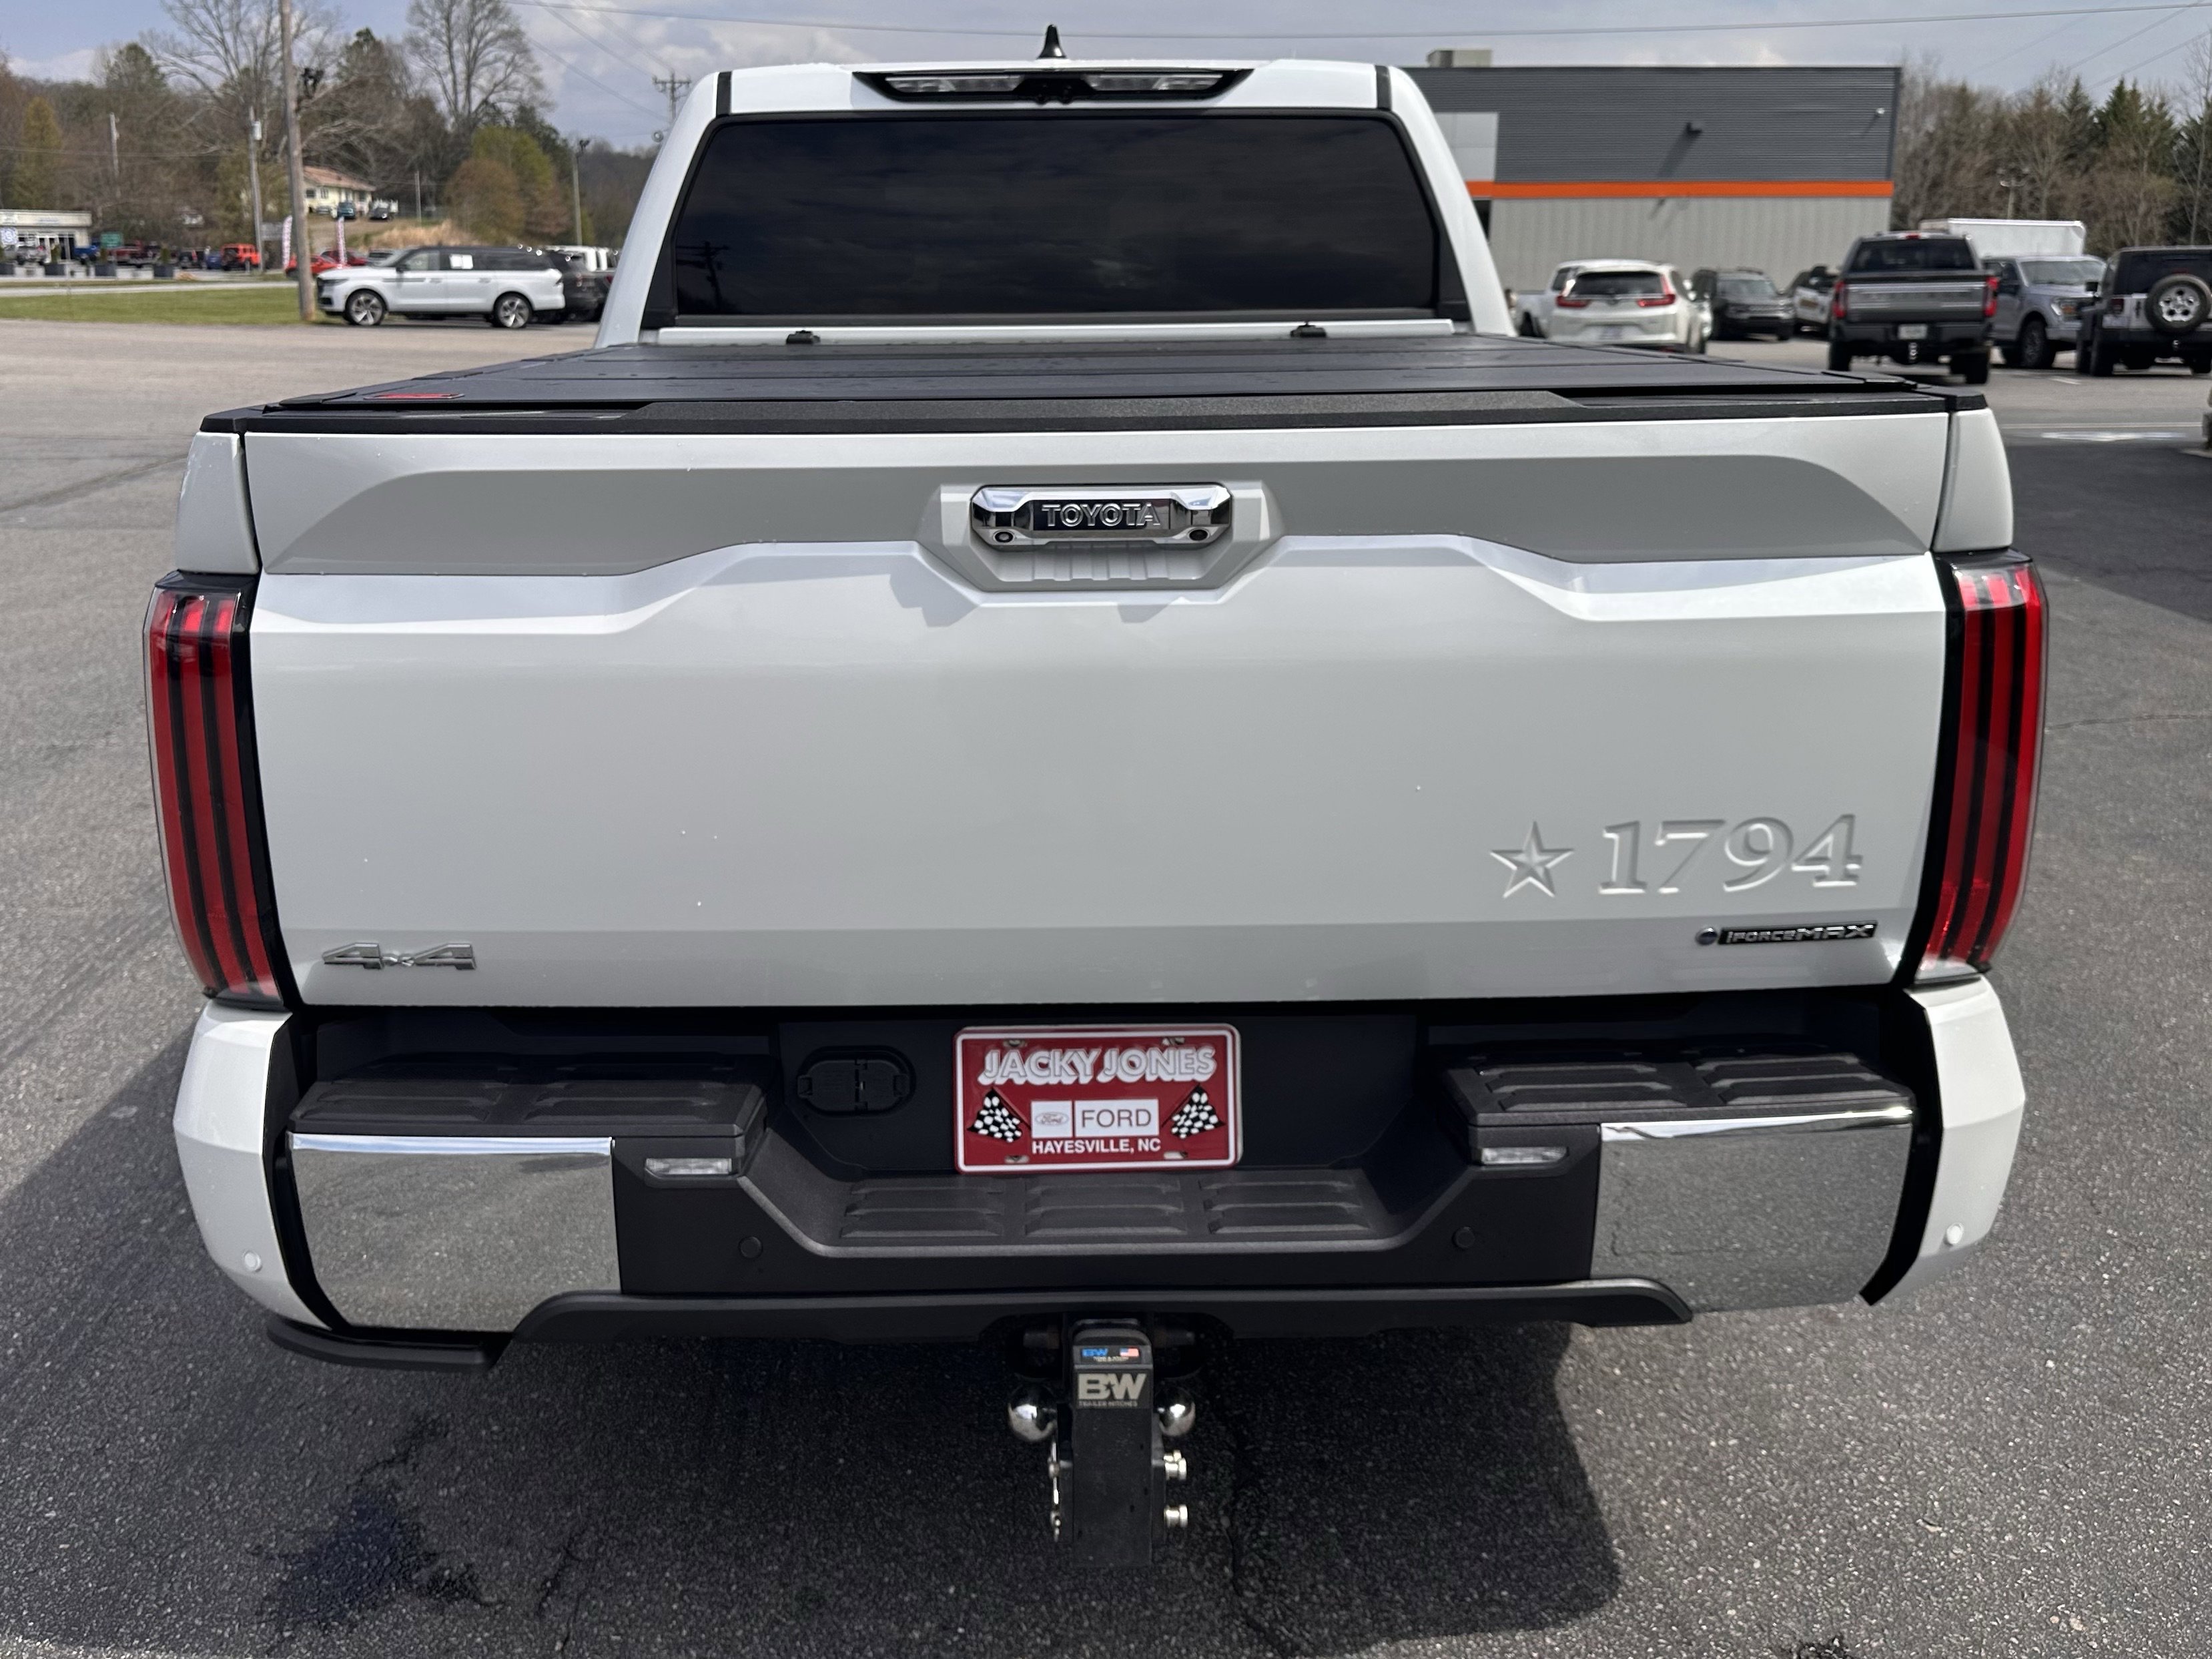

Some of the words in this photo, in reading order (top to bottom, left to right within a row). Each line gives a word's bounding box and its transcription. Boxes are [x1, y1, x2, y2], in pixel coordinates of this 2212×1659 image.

[1042, 503, 1161, 527] TOYOTA
[1599, 813, 1863, 895] 1794
[978, 1047, 1102, 1086] JACKY
[1096, 1046, 1218, 1083] JONES
[1081, 1108, 1152, 1128] FORD
[1032, 1138, 1134, 1154] HAYESVILLE,
[1137, 1138, 1161, 1152] NC
